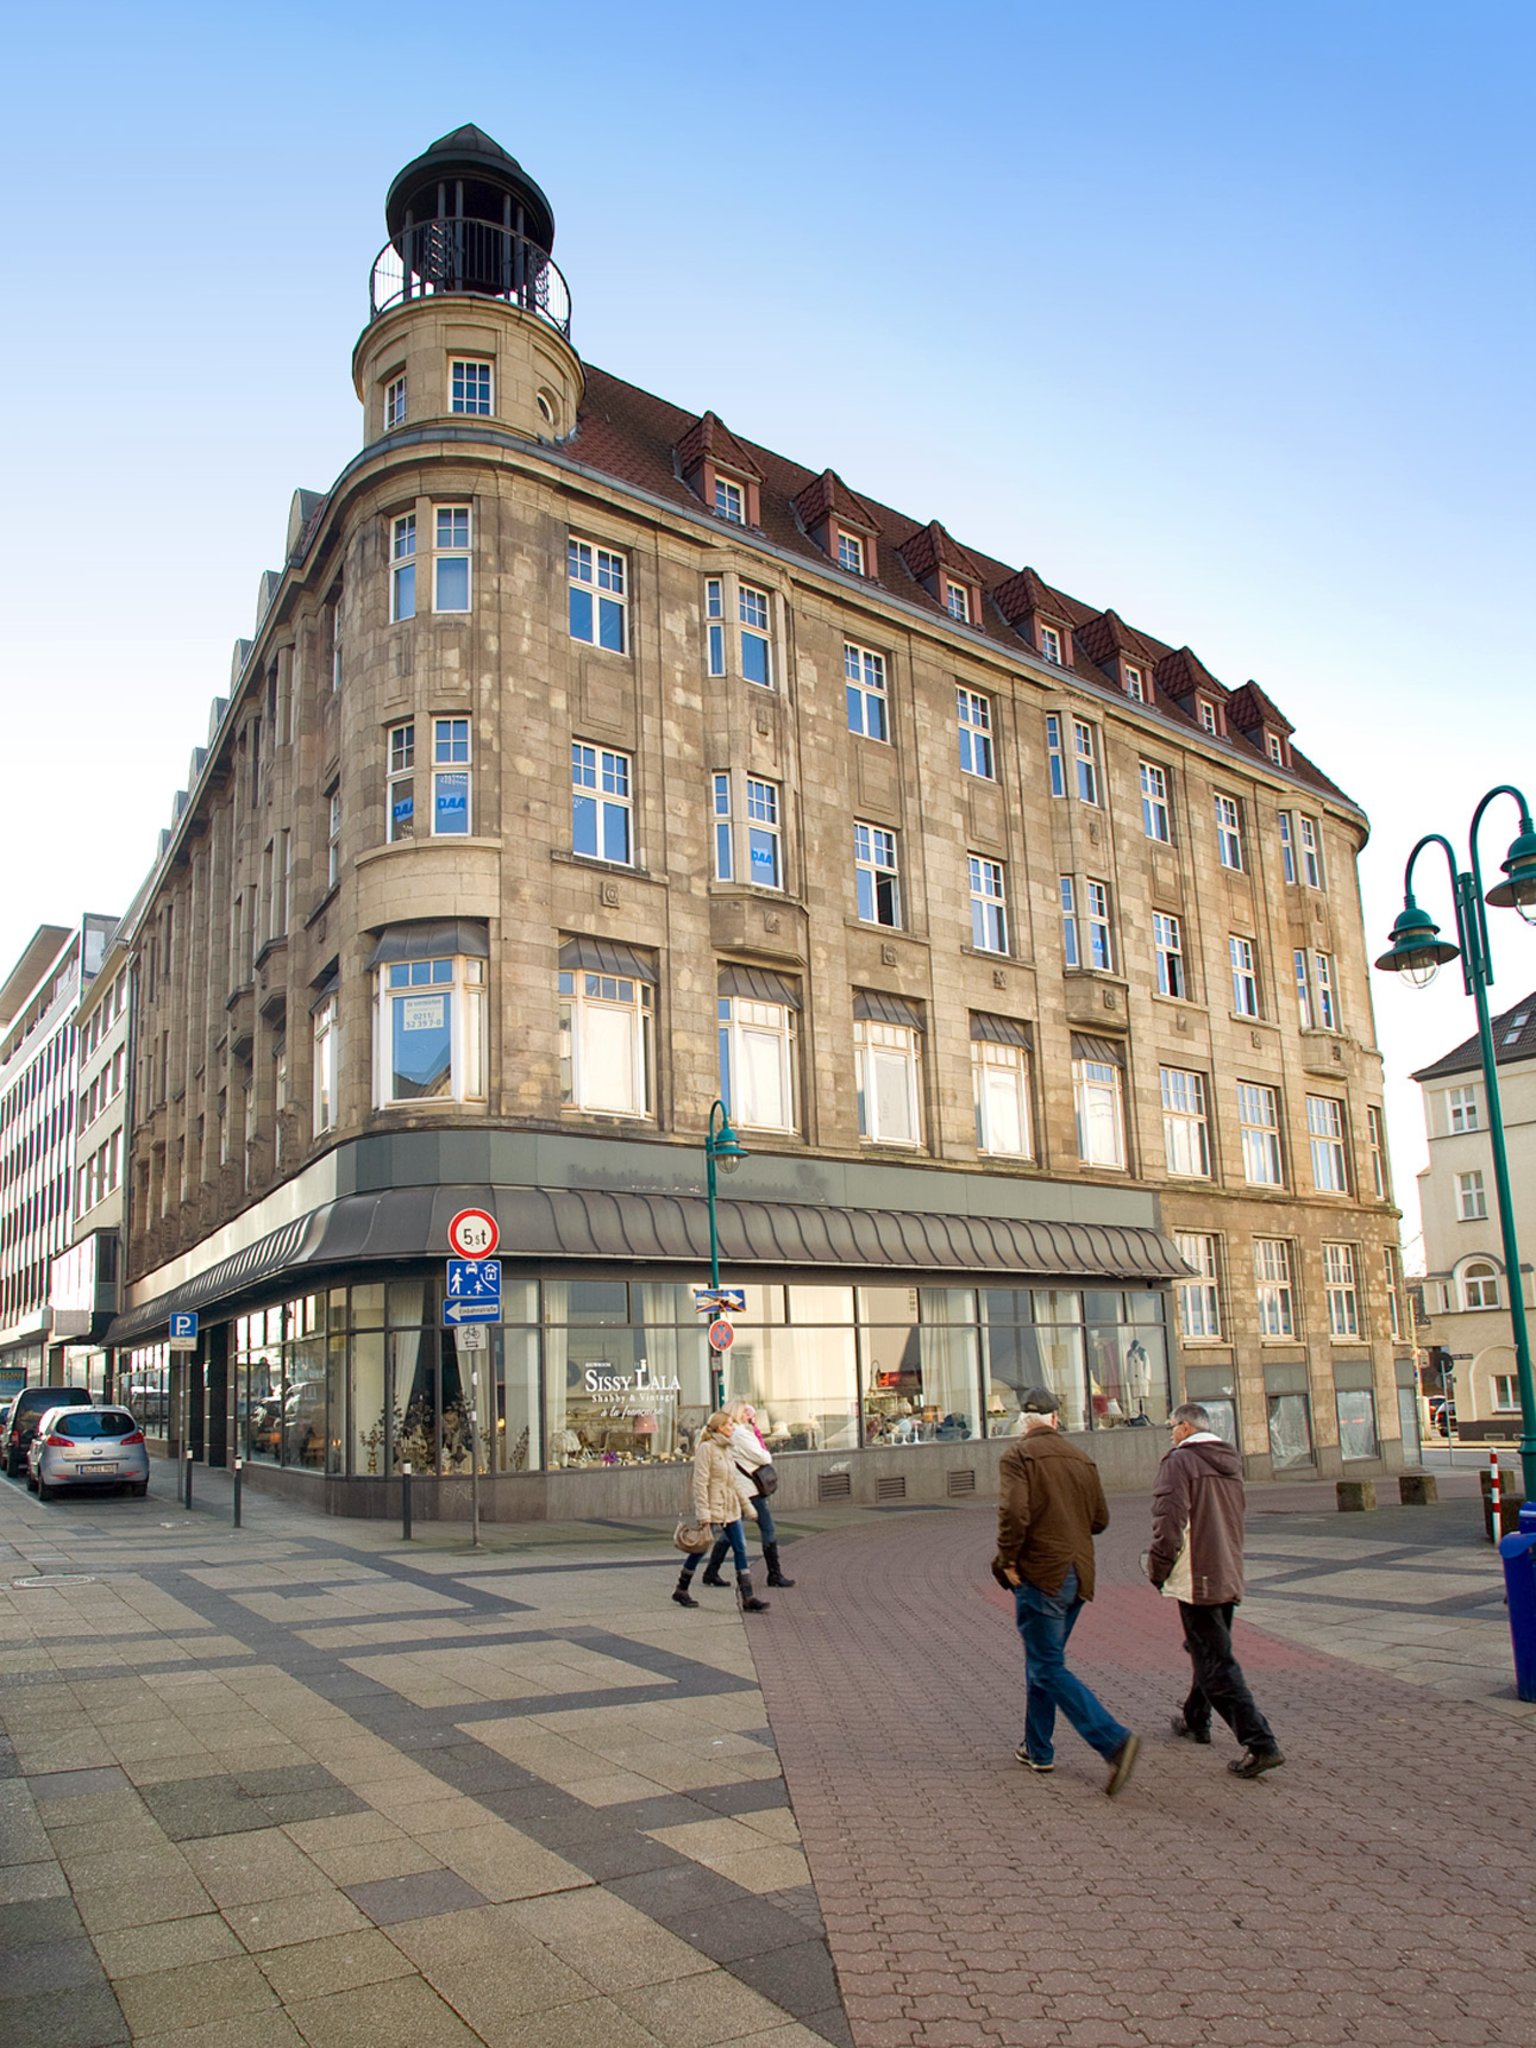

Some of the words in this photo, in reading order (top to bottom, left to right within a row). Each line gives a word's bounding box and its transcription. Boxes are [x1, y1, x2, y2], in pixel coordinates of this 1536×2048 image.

[438, 796, 466, 810] DAA
[752, 848, 772, 864] DAA
[459, 1306, 497, 1314] Einbahnstraße
[176, 1316, 191, 1335] P
[592, 1394, 625, 1404] Shabby
[640, 1394, 674, 1403] Vintage
[610, 1405, 620, 1417] la
